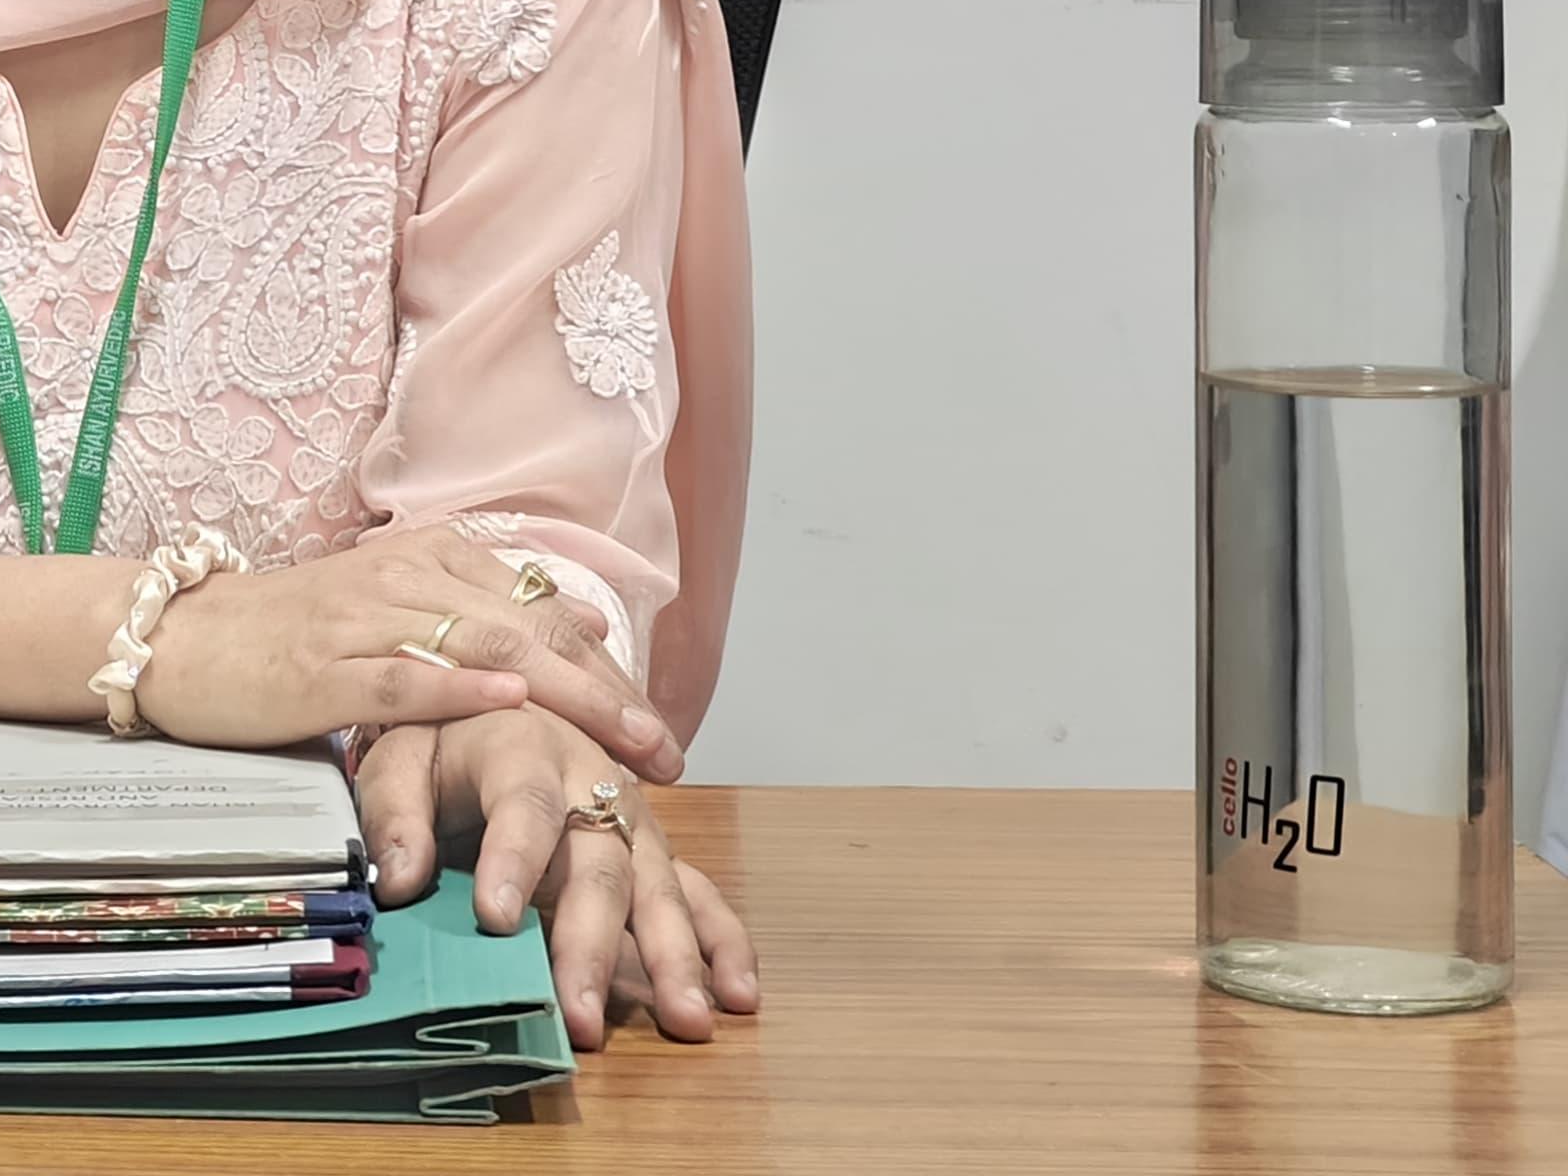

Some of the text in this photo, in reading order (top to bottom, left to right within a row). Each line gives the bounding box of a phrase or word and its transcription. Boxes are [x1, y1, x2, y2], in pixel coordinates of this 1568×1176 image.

[77, 309, 127, 477] ISHAN AYURVEDIC
[1222, 757, 1239, 836] cello
